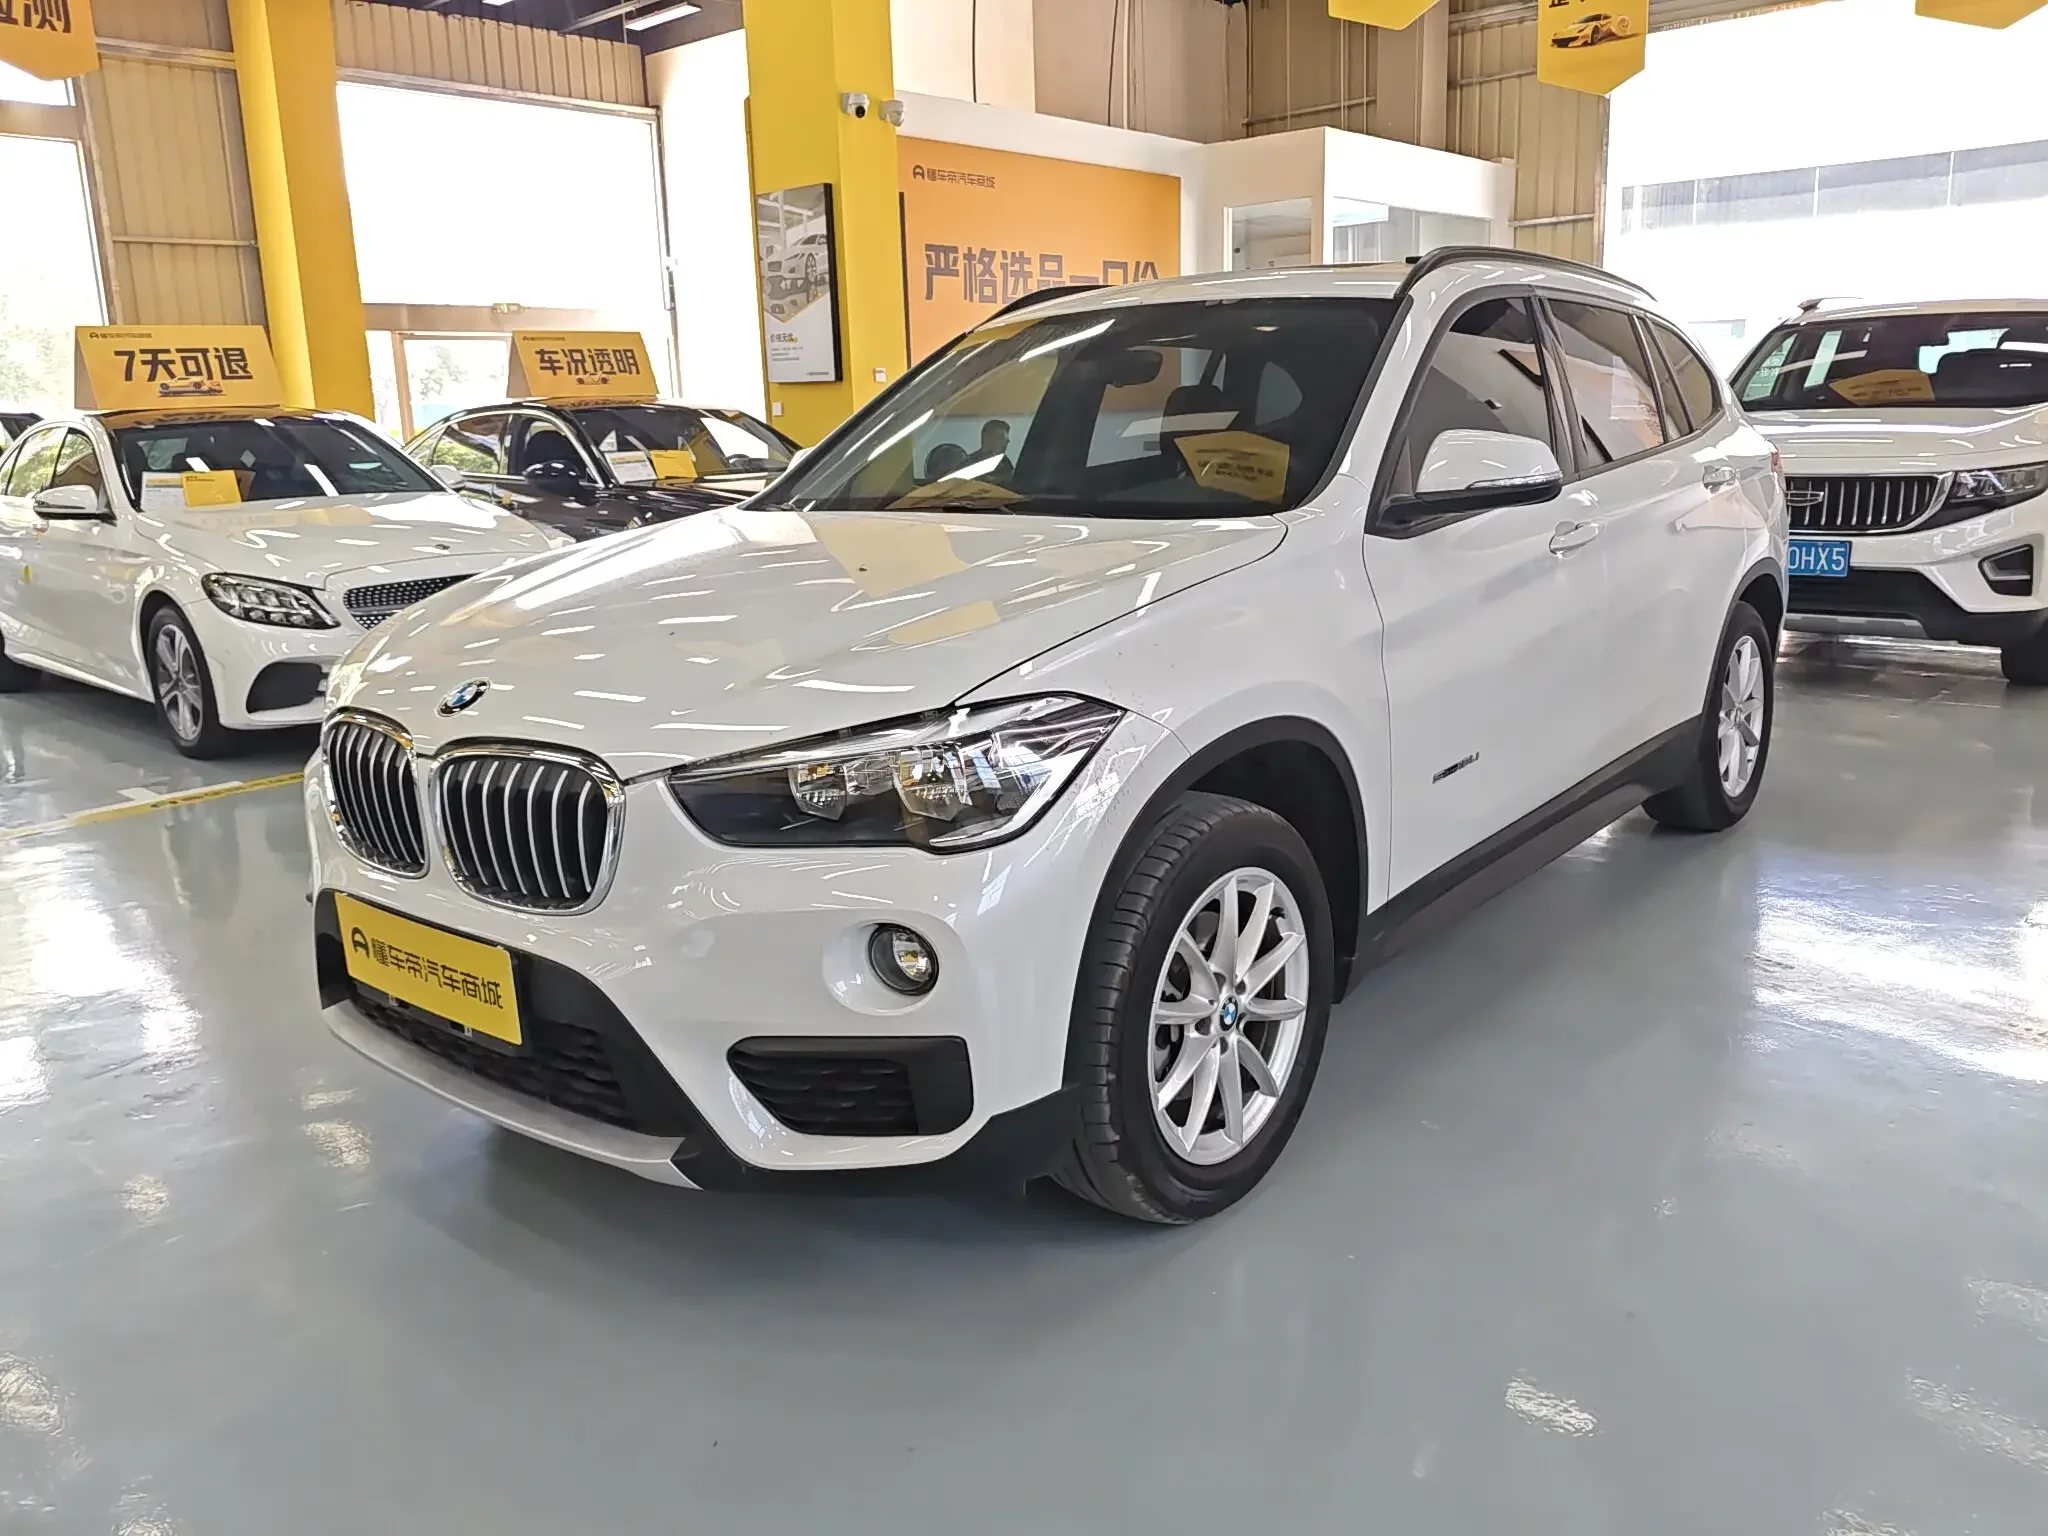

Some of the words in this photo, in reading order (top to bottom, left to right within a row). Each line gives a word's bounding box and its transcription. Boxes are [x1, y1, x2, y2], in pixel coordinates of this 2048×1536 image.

[113, 347, 253, 382] 7天可退
[535, 348, 640, 376] 车况透明
[371, 937, 504, 1009] 懂车帝汽车商城
